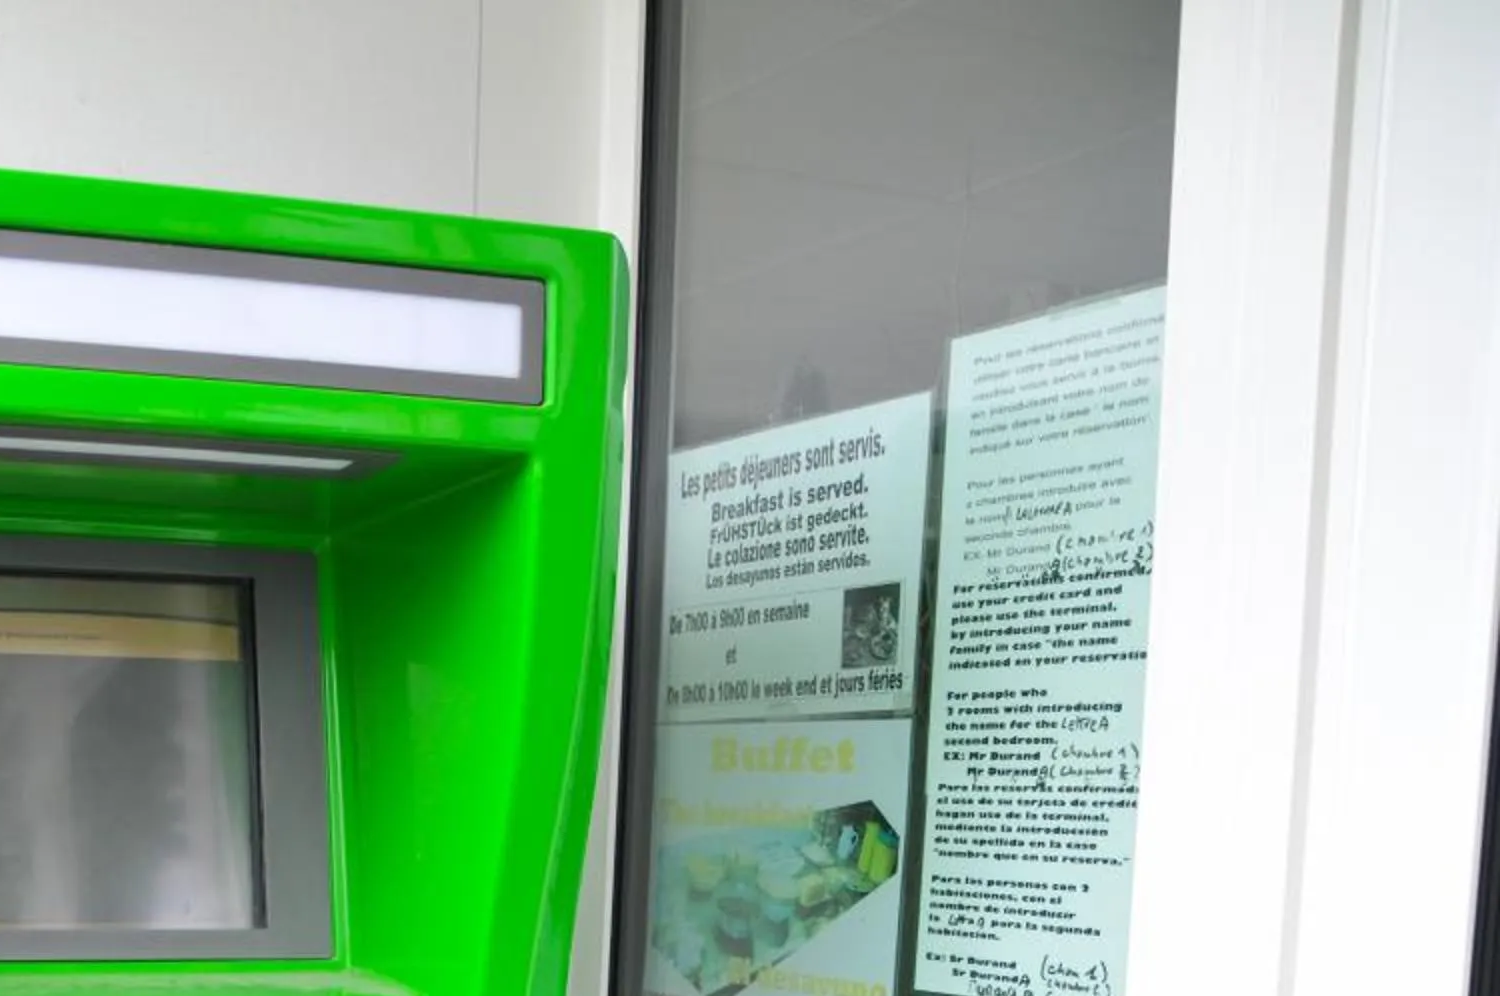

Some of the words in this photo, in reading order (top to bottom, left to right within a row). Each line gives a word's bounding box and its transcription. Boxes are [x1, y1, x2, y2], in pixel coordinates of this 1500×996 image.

[681, 471, 700, 498] Les
[703, 464, 738, 500] petits
[805, 437, 835, 471] sont
[839, 427, 885, 464] servis.
[712, 492, 784, 523] Breakfast
[790, 487, 801, 507] is
[808, 473, 868, 504] served.
[786, 515, 803, 530] ist
[808, 502, 868, 532] gedeckt.
[725, 536, 781, 567] colazione
[785, 539, 815, 557] sono
[819, 524, 869, 550] servite.
[727, 566, 781, 588] desayunos
[818, 552, 870, 573] servidos.
[952, 600, 974, 609] use
[978, 597, 1008, 608] your
[1013, 592, 1054, 604] credit
[1059, 588, 1091, 599] card
[1096, 584, 1123, 596] and
[953, 584, 975, 594] For
[748, 611, 760, 624] en
[763, 600, 810, 623] semaine
[952, 613, 992, 626] please
[996, 612, 1019, 620] use
[1023, 608, 1045, 618] the
[951, 629, 966, 640] by
[969, 624, 1050, 639] introducing
[1055, 620, 1087, 633] your
[1092, 619, 1132, 628] name
[996, 643, 1008, 651] in
[1013, 641, 1042, 650] case
[1079, 635, 1118, 646] name
[726, 646, 737, 665] et
[949, 658, 1011, 670] indicated
[1015, 656, 1031, 665] on
[1036, 655, 1068, 667] your
[796, 676, 817, 696] end
[820, 677, 832, 693] et
[835, 673, 864, 699] jours
[947, 691, 969, 700] For
[972, 689, 1017, 701] people
[1021, 688, 1048, 697] who
[958, 706, 999, 715] rooms
[1004, 704, 1033, 713] with
[1037, 702, 1123, 713] introducing
[945, 721, 966, 731] the
[970, 721, 1005, 730] name
[1010, 719, 1032, 729] for
[1036, 719, 1058, 728] the
[944, 736, 989, 745] second
[993, 735, 1058, 745] bedroom.
[711, 736, 857, 772] Buffet
[969, 751, 987, 760] Mr
[990, 751, 1041, 760] Durand
[967, 767, 984, 776] Mr
[988, 767, 1039, 776] Durand
[938, 783, 968, 792] Para
[972, 783, 990, 792] las
[952, 797, 974, 805] uso
[978, 797, 993, 805] de
[998, 798, 1013, 806] su
[1017, 798, 1066, 809] tarjeta
[1070, 799, 1086, 808] de
[936, 809, 974, 819] hagan
[979, 810, 1001, 819] uso
[1005, 811, 1021, 820] de
[1025, 811, 1039, 820] la
[935, 823, 997, 833] mediante
[1001, 824, 1013, 833] la
[934, 836, 949, 844] de
[953, 836, 968, 845] su
[1029, 840, 1045, 849] en
[1049, 840, 1062, 849] la
[994, 851, 1017, 861] que
[1043, 854, 1058, 862] su
[932, 875, 961, 884] Para
[965, 876, 983, 885] las
[987, 878, 1048, 890] personas
[1022, 895, 1046, 904] con
[1050, 896, 1062, 905] el
[929, 901, 980, 912] nombre
[984, 905, 1000, 914] de
[1004, 906, 1076, 920] introducir
[991, 919, 1021, 930] para
[1025, 922, 1038, 931] la
[1042, 924, 1100, 937] segunda
[950, 954, 964, 964] Sr
[968, 956, 1017, 969] Durand
[952, 967, 967, 977] Sr
[970, 969, 1019, 984] Durand
